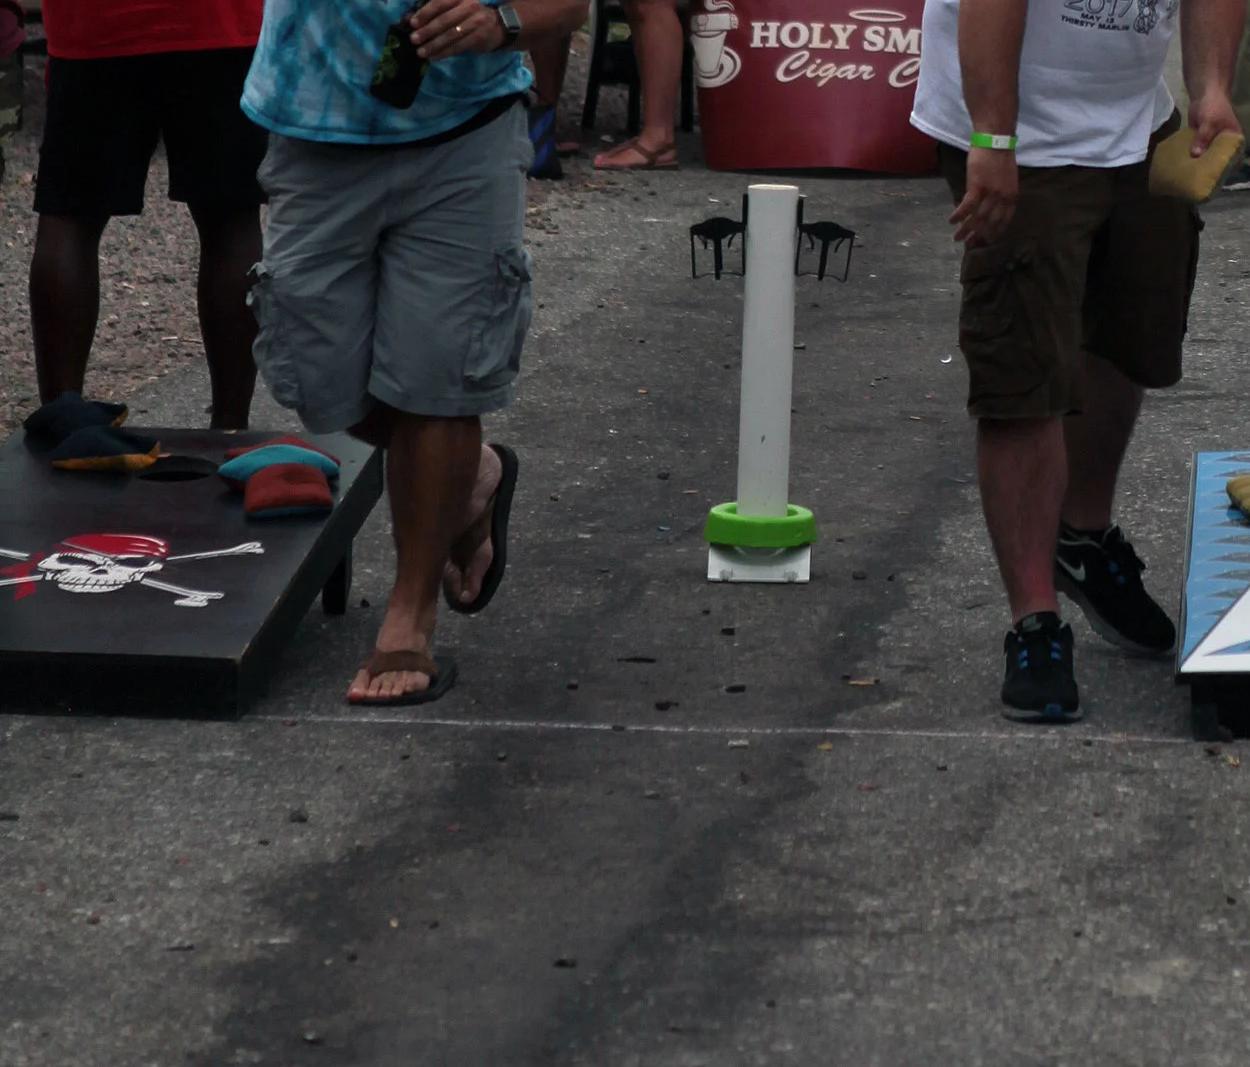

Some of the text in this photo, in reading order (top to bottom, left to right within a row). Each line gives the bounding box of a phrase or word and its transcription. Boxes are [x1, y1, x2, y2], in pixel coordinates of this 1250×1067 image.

[750, 22, 858, 50] HOLY
[1060, 15, 1096, 29] THIRSTY
[775, 50, 877, 87] Cigar
